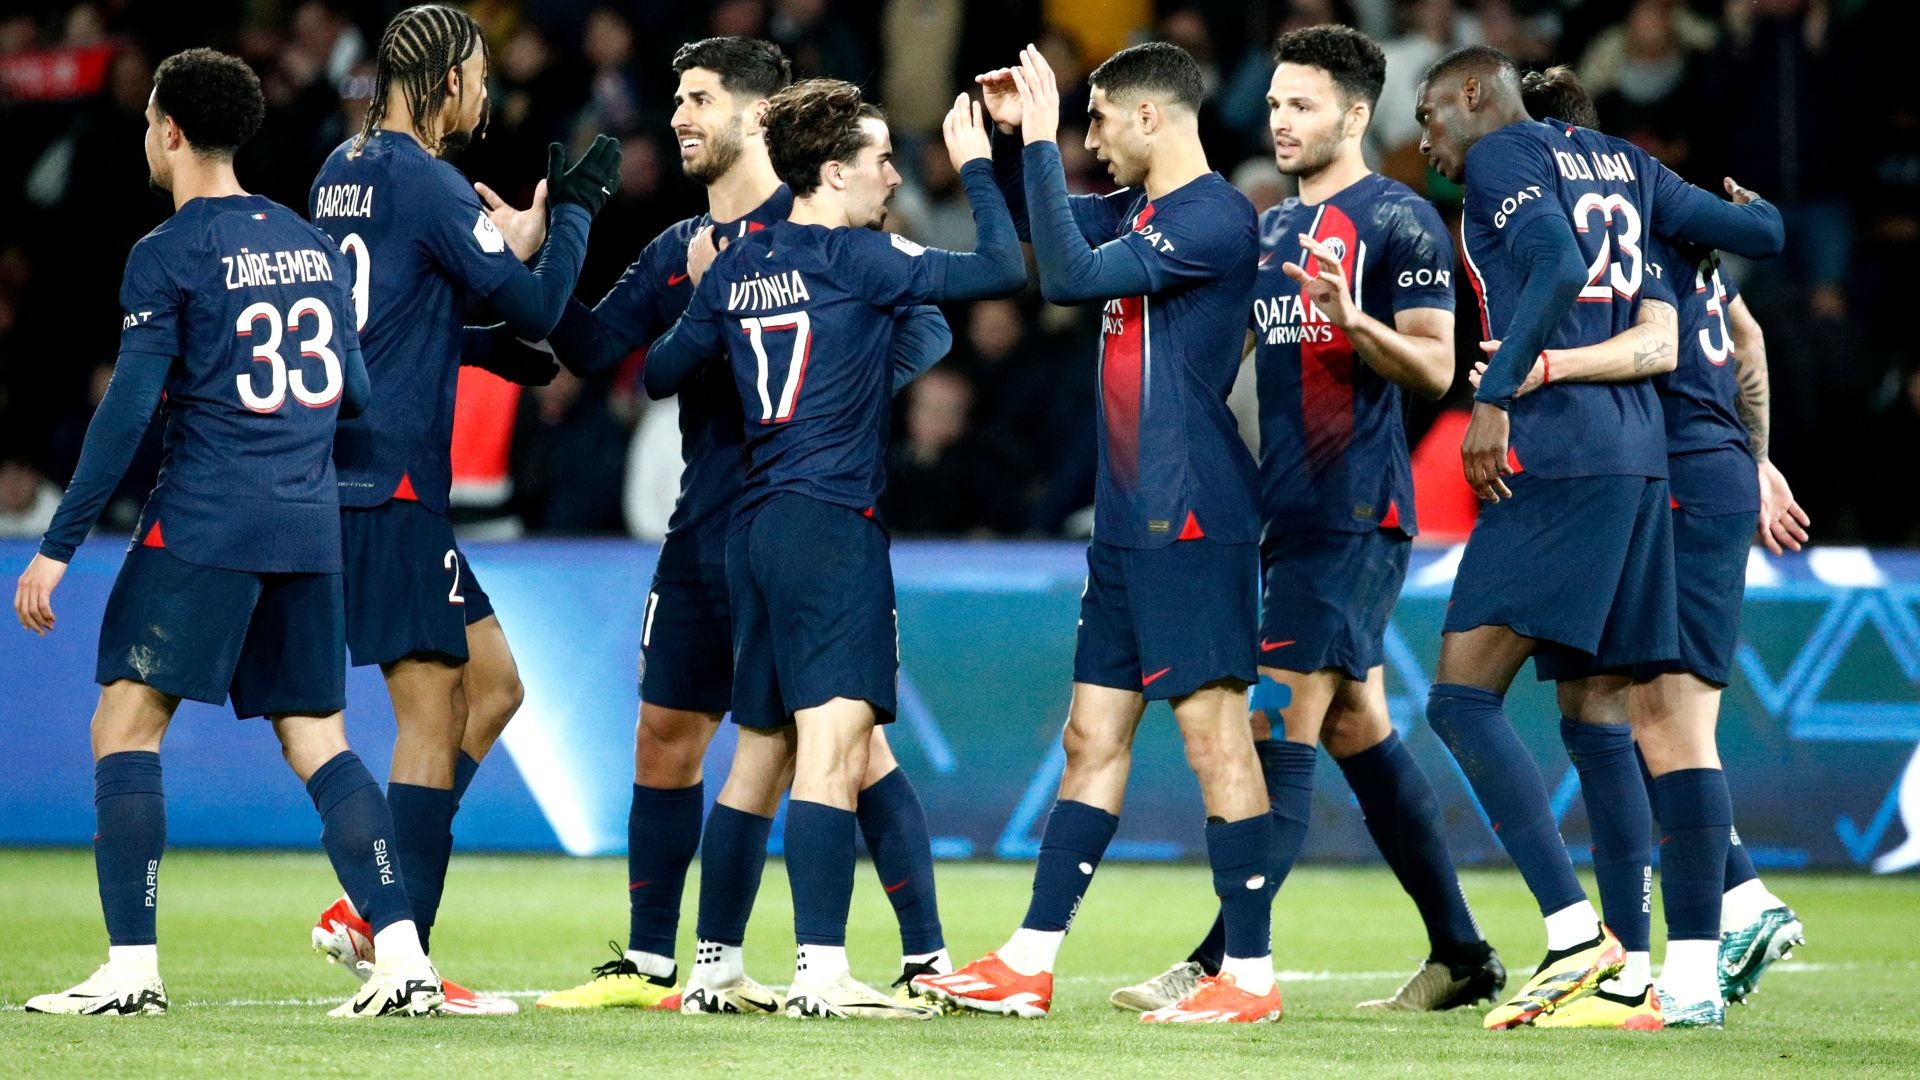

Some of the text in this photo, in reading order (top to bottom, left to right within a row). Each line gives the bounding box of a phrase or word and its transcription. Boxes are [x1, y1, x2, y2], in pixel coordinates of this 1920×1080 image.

[1553, 148, 1594, 181] OLO
[316, 184, 373, 218] BARCOLA
[1494, 186, 1542, 229] GOAT
[1138, 224, 1175, 252] OAT
[1573, 192, 1643, 303] 23
[221, 247, 333, 290] ZAÏRE-EMERY
[1397, 268, 1451, 288] GOAT
[122, 311, 153, 331] OAT
[1253, 294, 1332, 333] QATAR
[1265, 324, 1333, 345] AIRWAYS
[236, 297, 343, 414] 33
[739, 310, 813, 425] 17
[145, 859, 158, 907] PARIS
[373, 838, 395, 886] PARIS
[1641, 865, 1652, 913] PARIS
